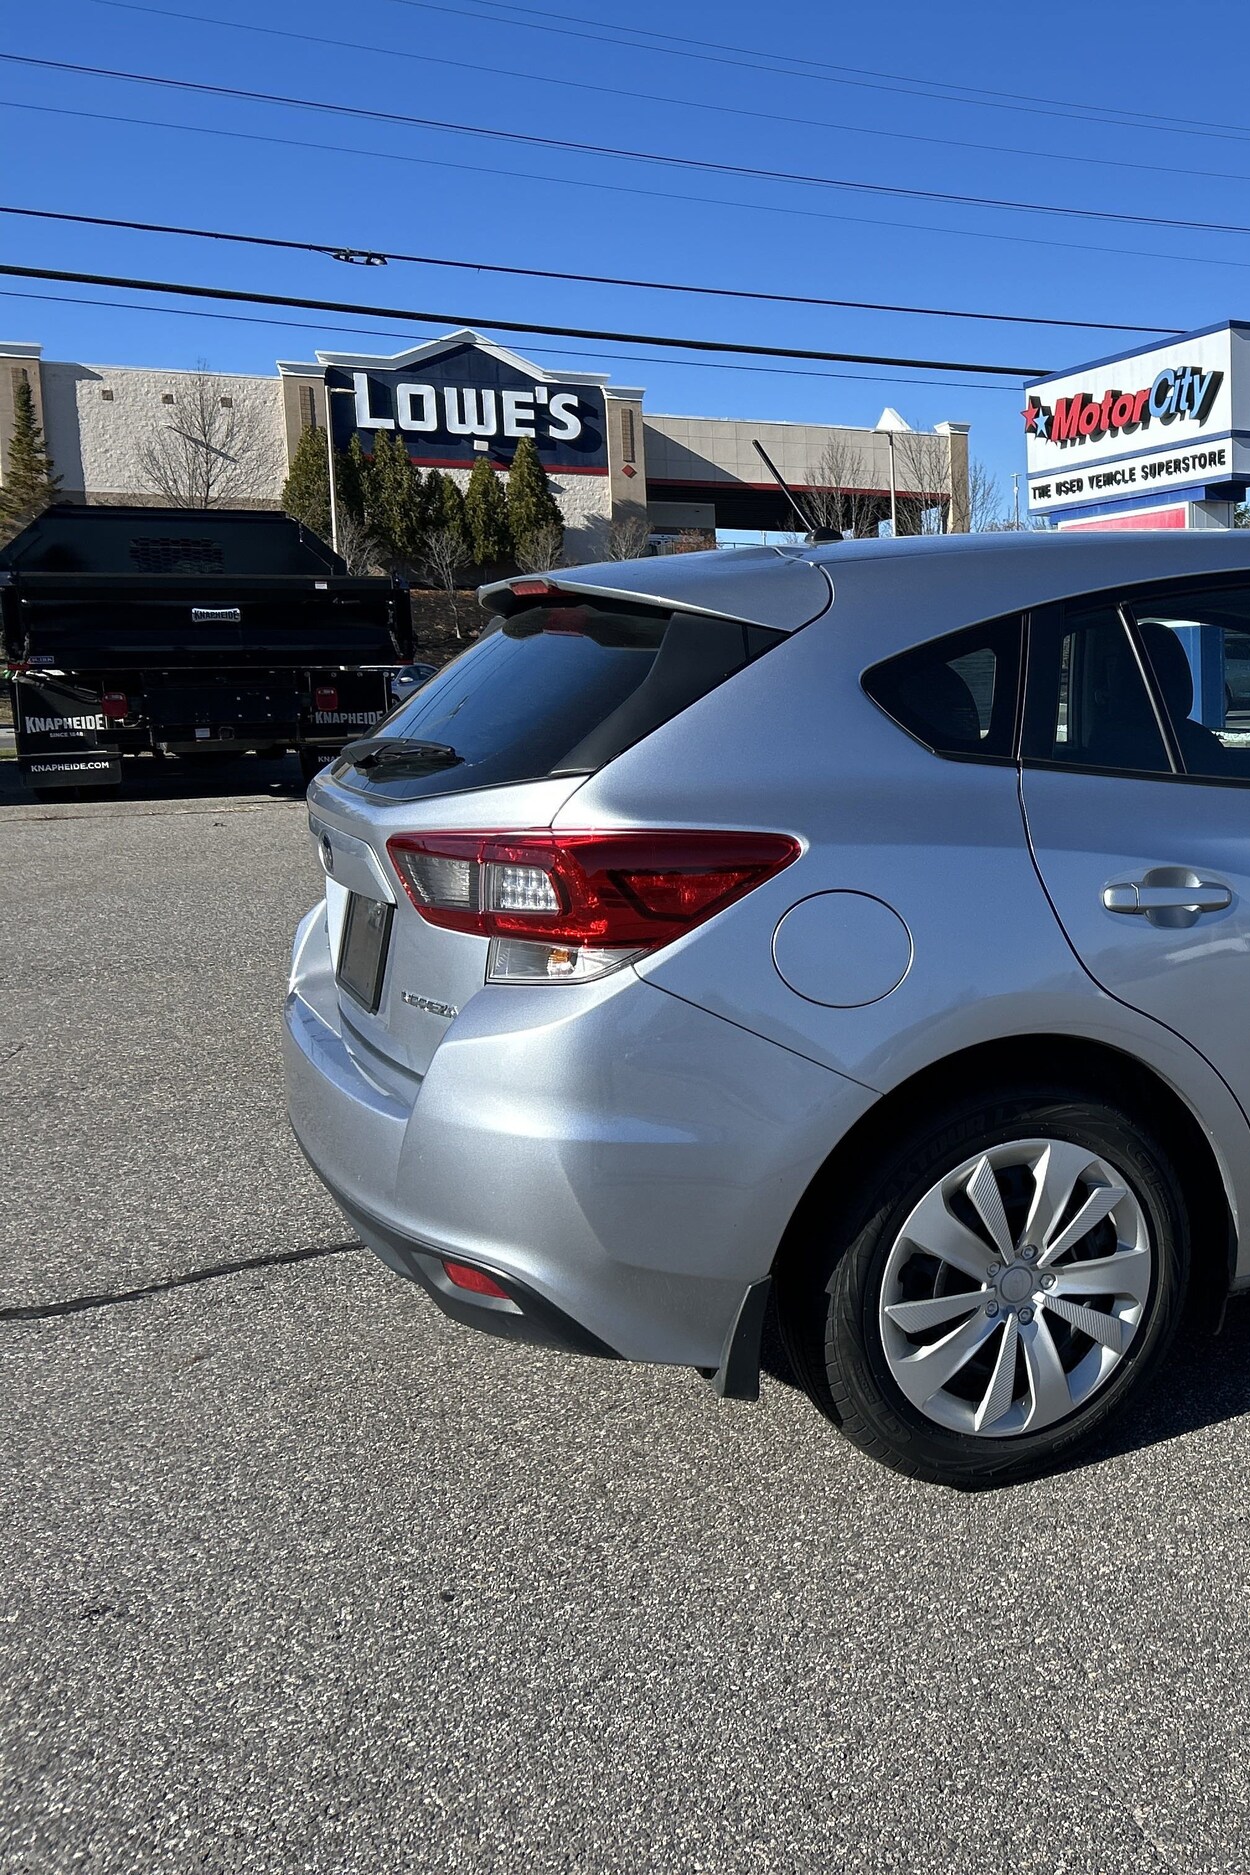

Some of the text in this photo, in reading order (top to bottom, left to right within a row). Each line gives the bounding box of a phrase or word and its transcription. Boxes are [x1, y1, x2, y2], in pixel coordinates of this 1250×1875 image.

[353, 372, 582, 441] LOWE'S
[1031, 449, 1226, 499] THE USED VEHICLE SUPERSTORE
[194, 608, 240, 620] KNAPHEIDE
[25, 714, 105, 734] KNAPHEIDE
[31, 761, 110, 772] KNAPHEIDE.COM
